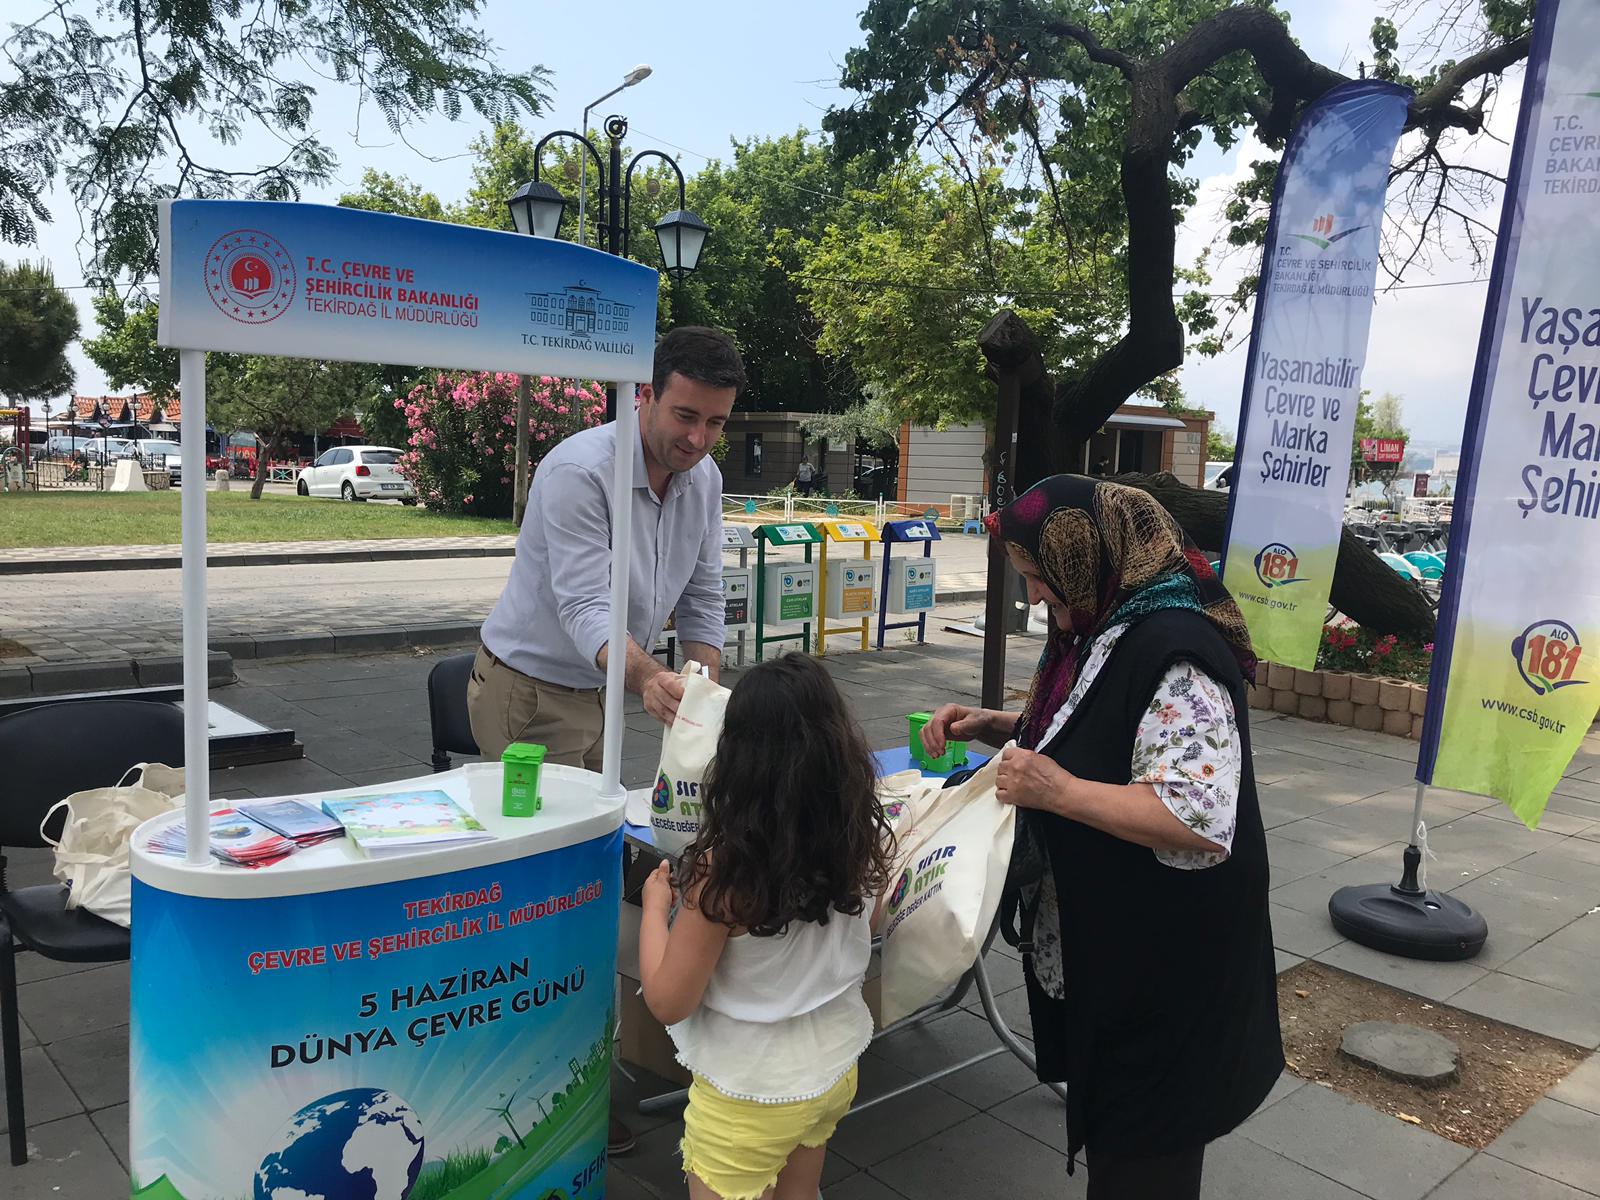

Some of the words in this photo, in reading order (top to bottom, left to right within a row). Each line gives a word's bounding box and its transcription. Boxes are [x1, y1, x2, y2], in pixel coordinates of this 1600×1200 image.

[1553, 115, 1584, 131] T.C.
[306, 256, 336, 274] T.C.
[342, 261, 391, 280] ÇEVRE
[395, 268, 414, 283] VE
[1305, 259, 1315, 270] VE
[305, 277, 393, 301] ŞEHİRCİLİK
[398, 287, 479, 310] BAKANLIĞI
[305, 297, 377, 317] TEKİRDAĞ
[381, 302, 392, 319] İL
[395, 305, 478, 328] MÜDÜRLÜĞÜ
[521, 333, 539, 346] T.C.
[541, 336, 592, 351] TEKİRDAĞ
[594, 340, 634, 355] VALİLİĞİ
[1260, 351, 1359, 388] Yaşanabilir
[1264, 385, 1316, 419] Çevre
[1322, 397, 1340, 421] ve
[1271, 419, 1328, 454] Marka
[1260, 450, 1331, 488] Şehirler
[1262, 552, 1298, 579] 181
[1239, 591, 1298, 612] www.csb.gov.tr
[1550, 628, 1569, 641] ALO
[1527, 634, 1582, 680] 181
[1481, 698, 1566, 734] www.csb.gov.tr
[676, 780, 701, 797] SIF
[680, 801, 702, 816] AT
[916, 845, 957, 875] SIFIR
[913, 861, 949, 894] ATIK
[403, 882, 502, 919] TEKİRDAĞ
[248, 946, 327, 975] ÇEVRE
[332, 941, 362, 961] VE
[367, 917, 483, 960] ŞEHİRCİLİK
[487, 912, 504, 931] İL
[509, 879, 603, 926] MÜDÜRLÜĞÜ
[358, 993, 378, 1018] 5
[391, 957, 529, 1012] HAZİRAN
[270, 1032, 398, 1068] DÜNYA
[407, 997, 502, 1046] ÇEVRE
[511, 964, 585, 1014] GÜNÜ
[572, 1147, 606, 1196] SIFIR
